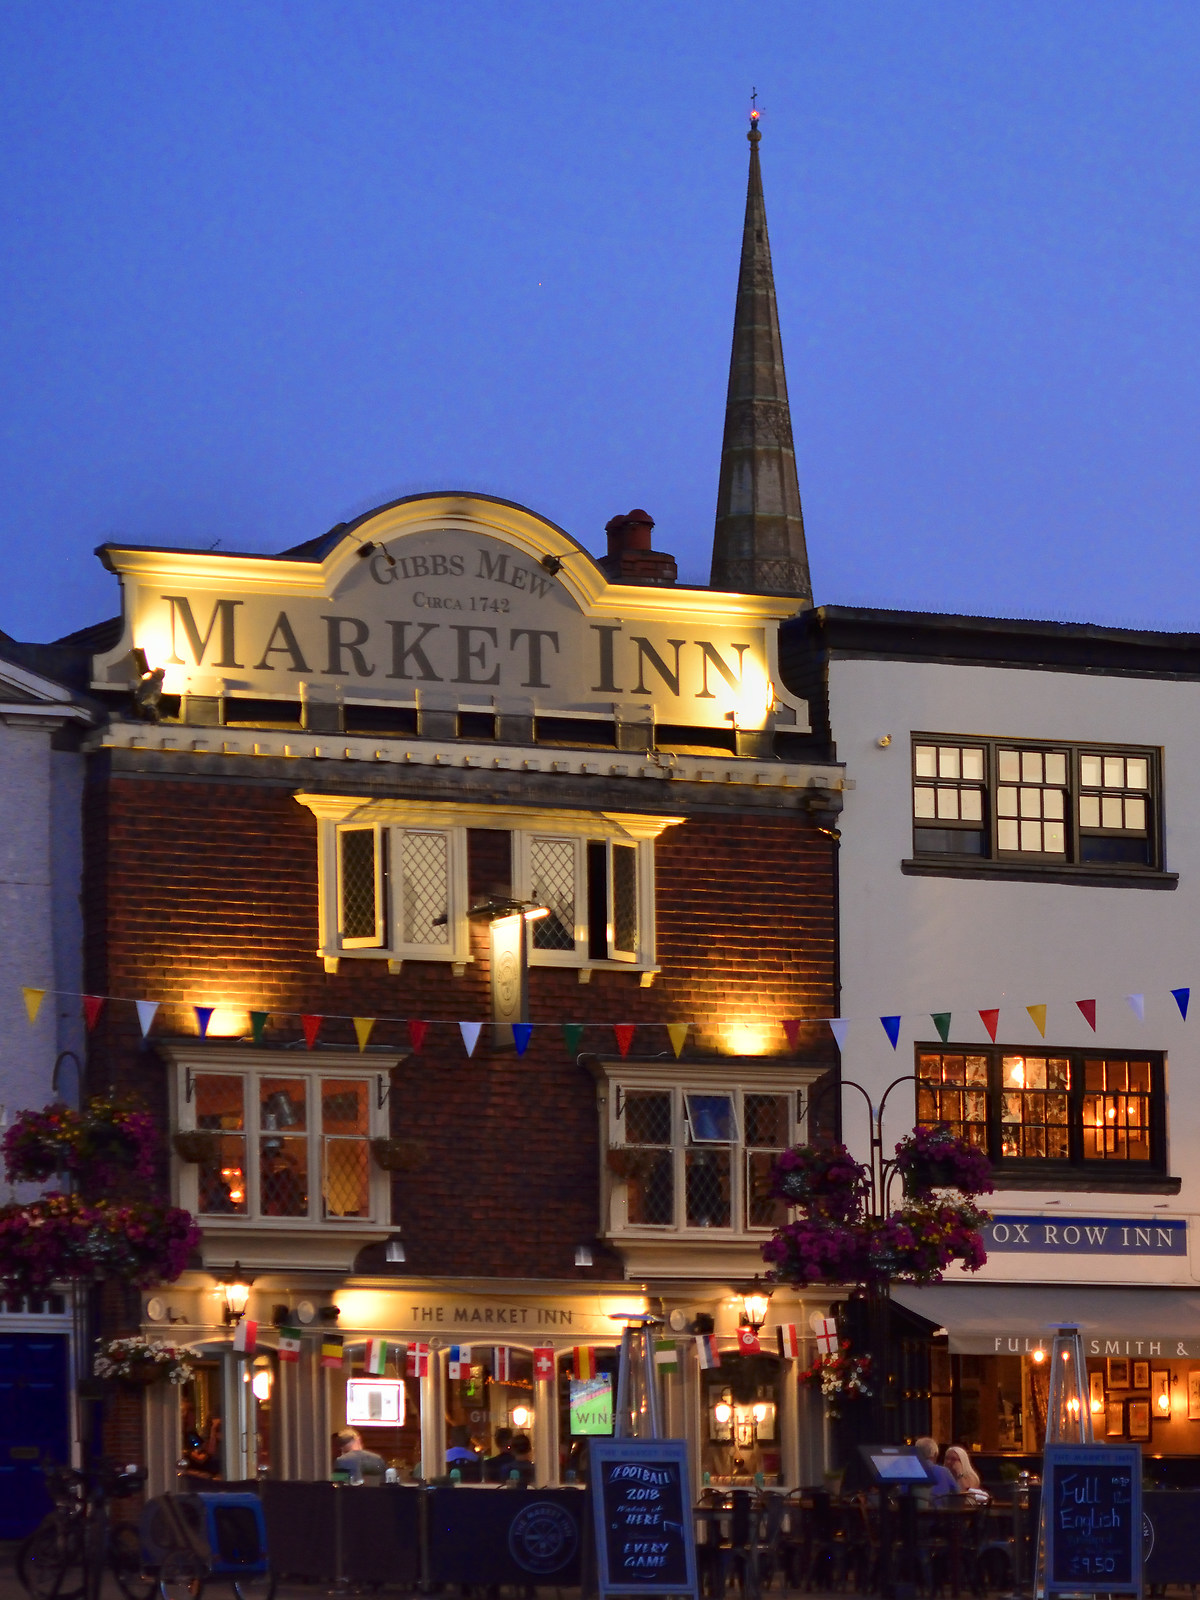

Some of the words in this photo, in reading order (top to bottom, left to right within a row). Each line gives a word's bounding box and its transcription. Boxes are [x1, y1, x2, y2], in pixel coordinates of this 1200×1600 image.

[369, 553, 465, 586] GIBBS
[474, 549, 554, 600] MEW
[412, 591, 463, 610] CIRCA
[469, 596, 510, 613] 1742
[160, 594, 561, 690] MARKET
[589, 624, 751, 699] INN
[992, 1223, 1030, 1243] OX
[1044, 1225, 1109, 1246] ROW
[1121, 1227, 1173, 1247] INN
[411, 1306, 444, 1322] THE
[453, 1308, 528, 1324] MARKET
[537, 1310, 573, 1325] INN
[994, 1338, 1048, 1352] FULL
[1090, 1341, 1162, 1355] SMITH
[1176, 1343, 1189, 1356] &
[577, 1412, 616, 1425] WINE
[611, 1466, 670, 1484] FOOTBALL
[626, 1489, 660, 1500] 2018
[1060, 1473, 1101, 1506] Full
[626, 1514, 661, 1525] HERE
[1060, 1508, 1120, 1536] English
[623, 1543, 669, 1553] EVERY
[624, 1556, 668, 1567] GAME
